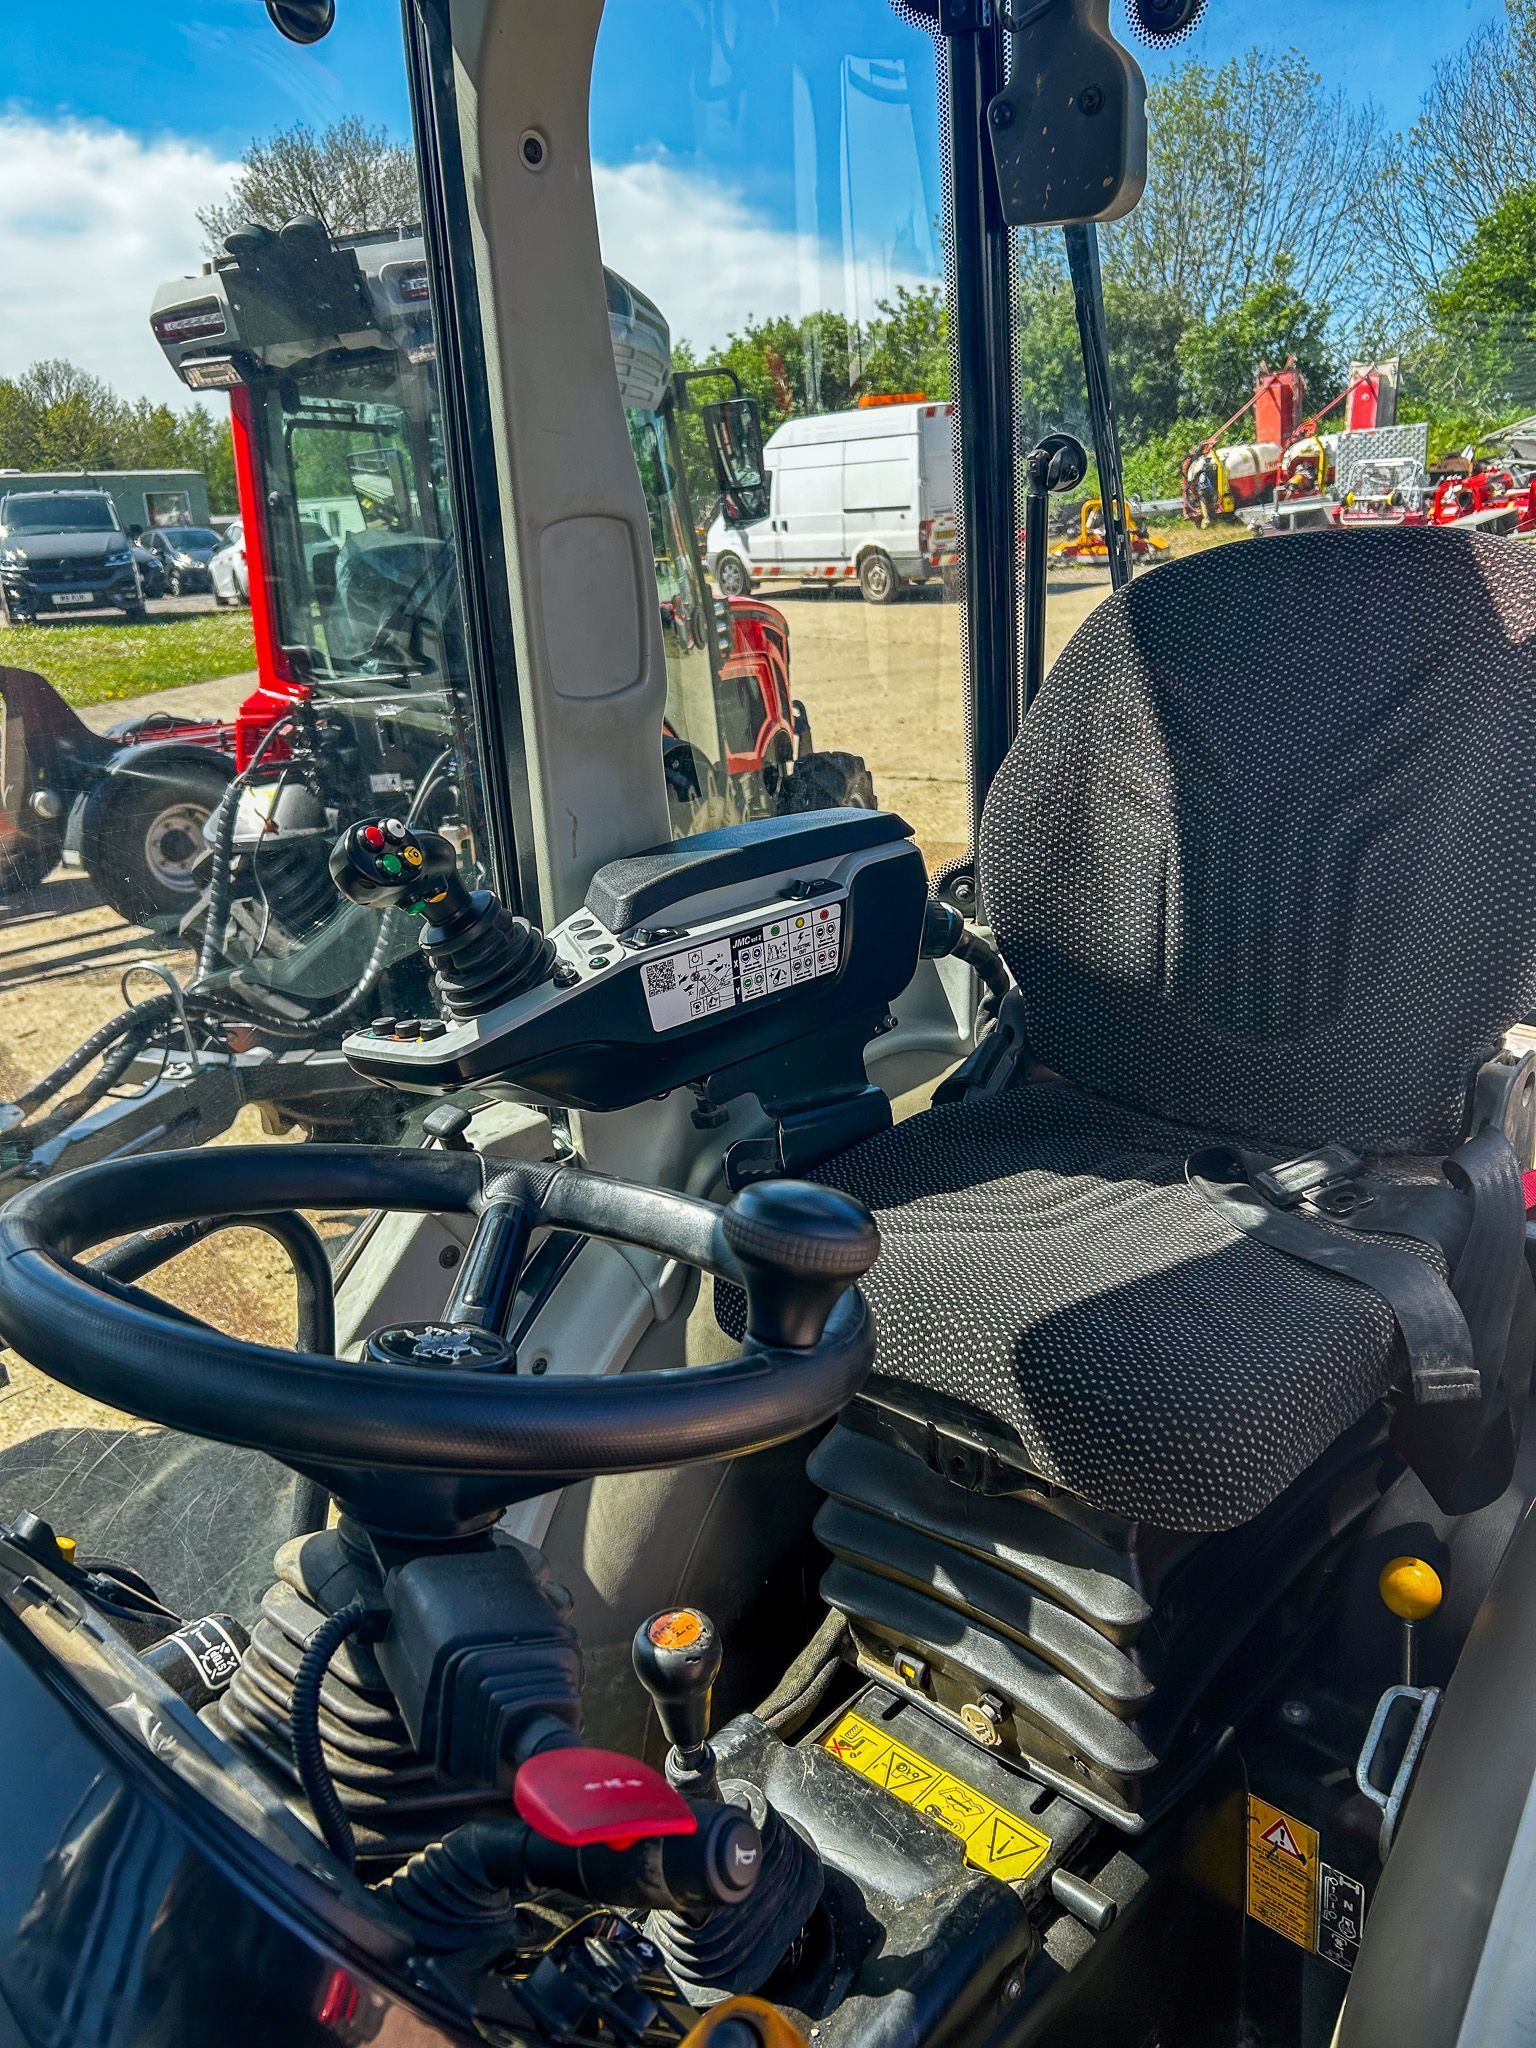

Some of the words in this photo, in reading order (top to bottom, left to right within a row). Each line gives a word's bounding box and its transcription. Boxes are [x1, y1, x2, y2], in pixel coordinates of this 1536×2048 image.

[732, 936, 751, 949] JMC
[793, 941, 811, 951] ELECTRIC
[733, 960, 739, 968] X
[735, 987, 741, 995] Y
[209, 1650, 227, 1671] STOP
